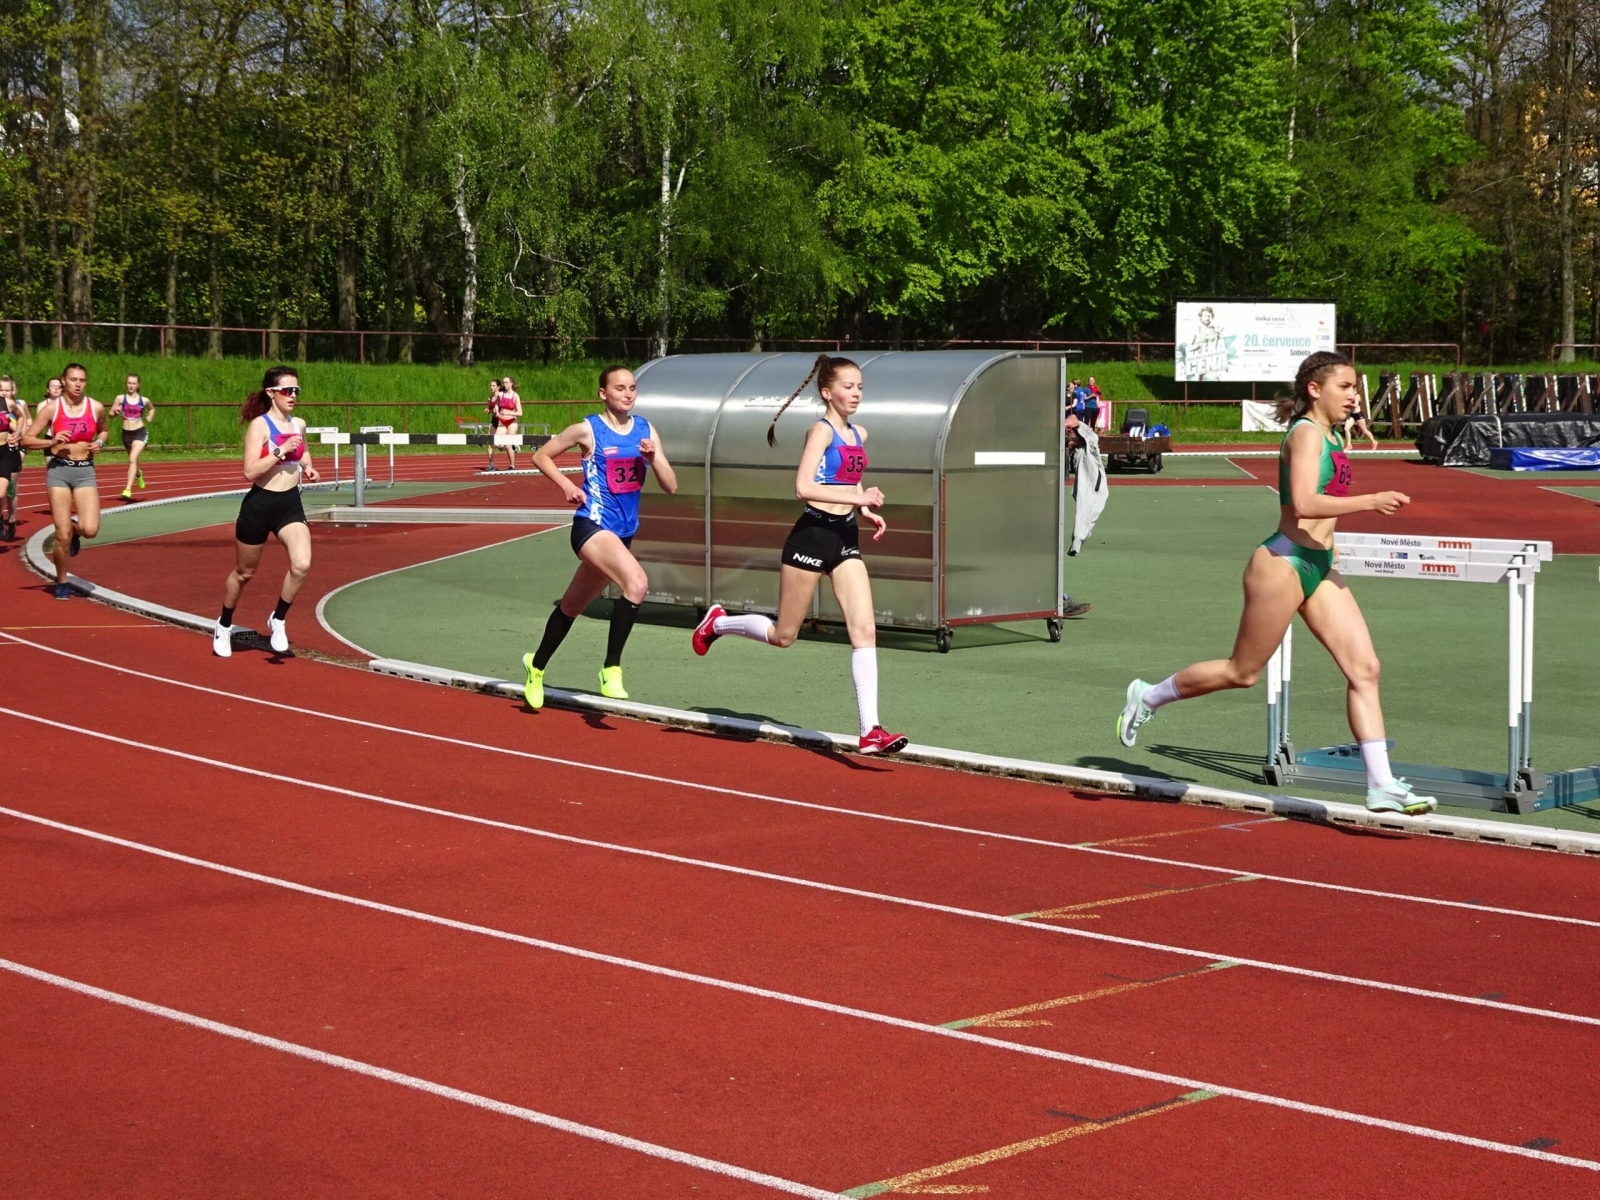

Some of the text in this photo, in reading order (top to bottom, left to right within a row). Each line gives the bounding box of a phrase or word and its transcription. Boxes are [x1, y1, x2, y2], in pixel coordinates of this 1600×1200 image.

[1244, 334, 1311, 347] 20. července
[69, 422, 88, 434] 73
[846, 455, 864, 473] 35
[614, 466, 639, 484] 32
[1381, 538, 1421, 547] Nové Město
[792, 552, 823, 567] NIKE
[1364, 560, 1405, 570] Nové Město
